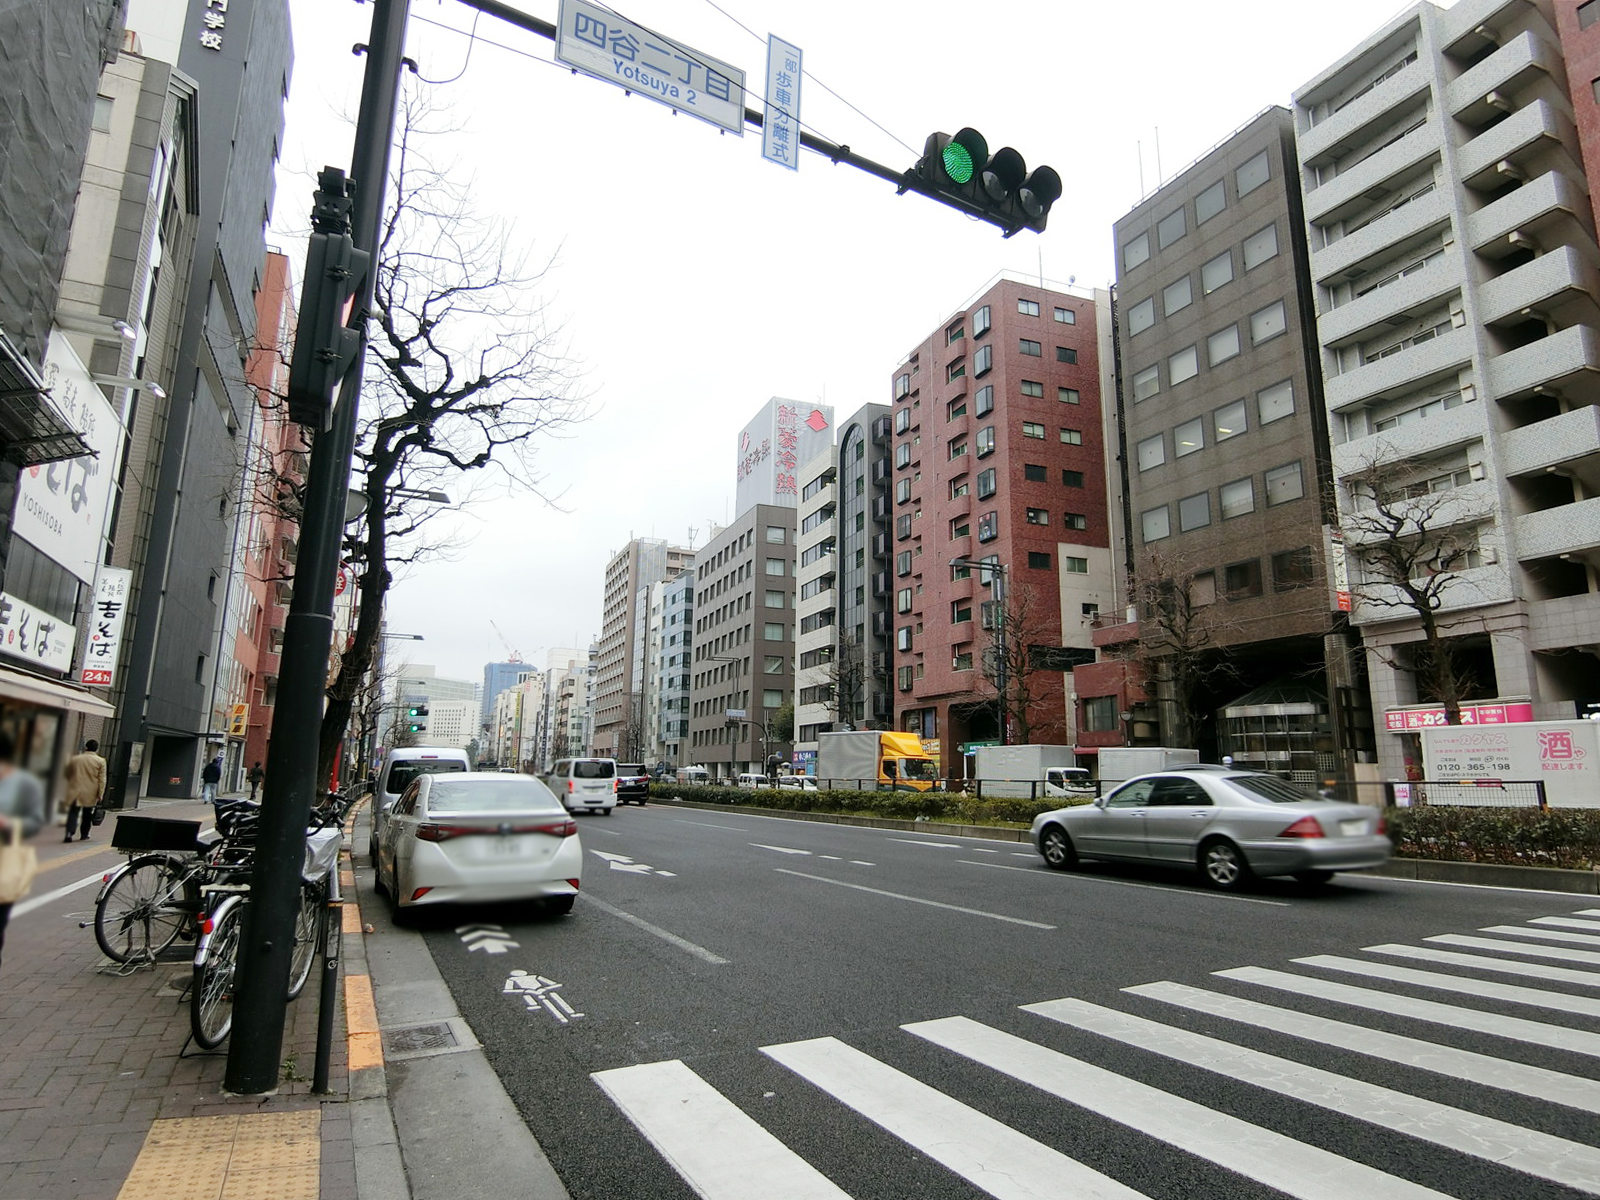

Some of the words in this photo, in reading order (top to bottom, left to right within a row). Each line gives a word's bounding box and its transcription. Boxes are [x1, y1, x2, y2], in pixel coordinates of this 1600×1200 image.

[574, 12, 730, 102] 四谷二丁目
[612, 58, 680, 99] Yotsuya
[686, 90, 697, 105] 2
[23, 492, 63, 537] YOSHISOBA
[90, 600, 122, 657] 吉そば
[84, 671, 111, 682] 24h
[1422, 711, 1474, 725] カクス
[1538, 730, 1585, 760] 酒や
[1436, 763, 1511, 771] 0120-365-198
